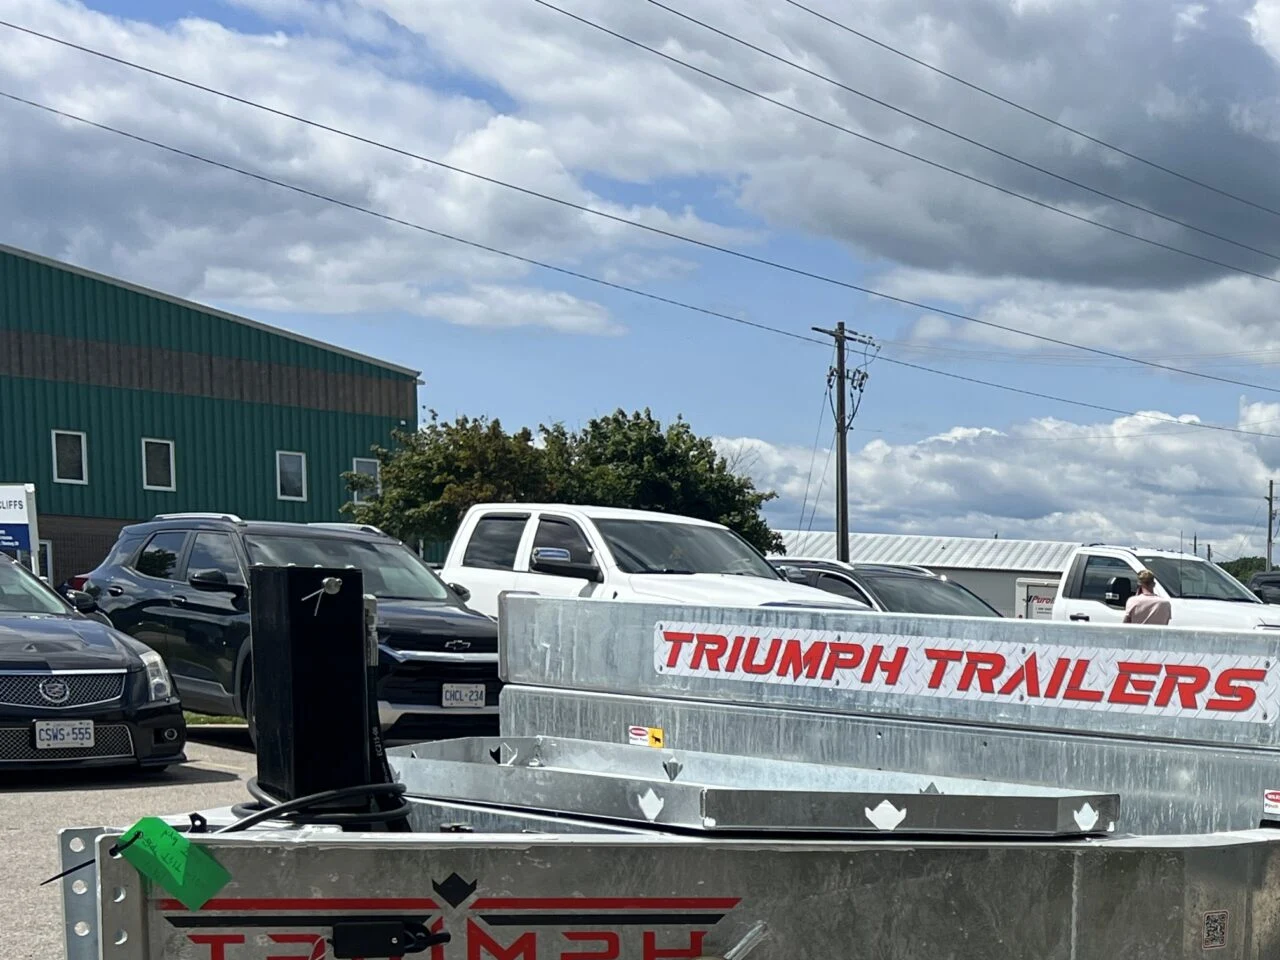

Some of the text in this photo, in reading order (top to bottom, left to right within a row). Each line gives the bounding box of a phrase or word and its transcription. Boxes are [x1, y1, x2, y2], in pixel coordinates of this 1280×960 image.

[663, 631, 1268, 712] TRIUMPH TRAILERS
[39, 727, 91, 741] CSWS 555
